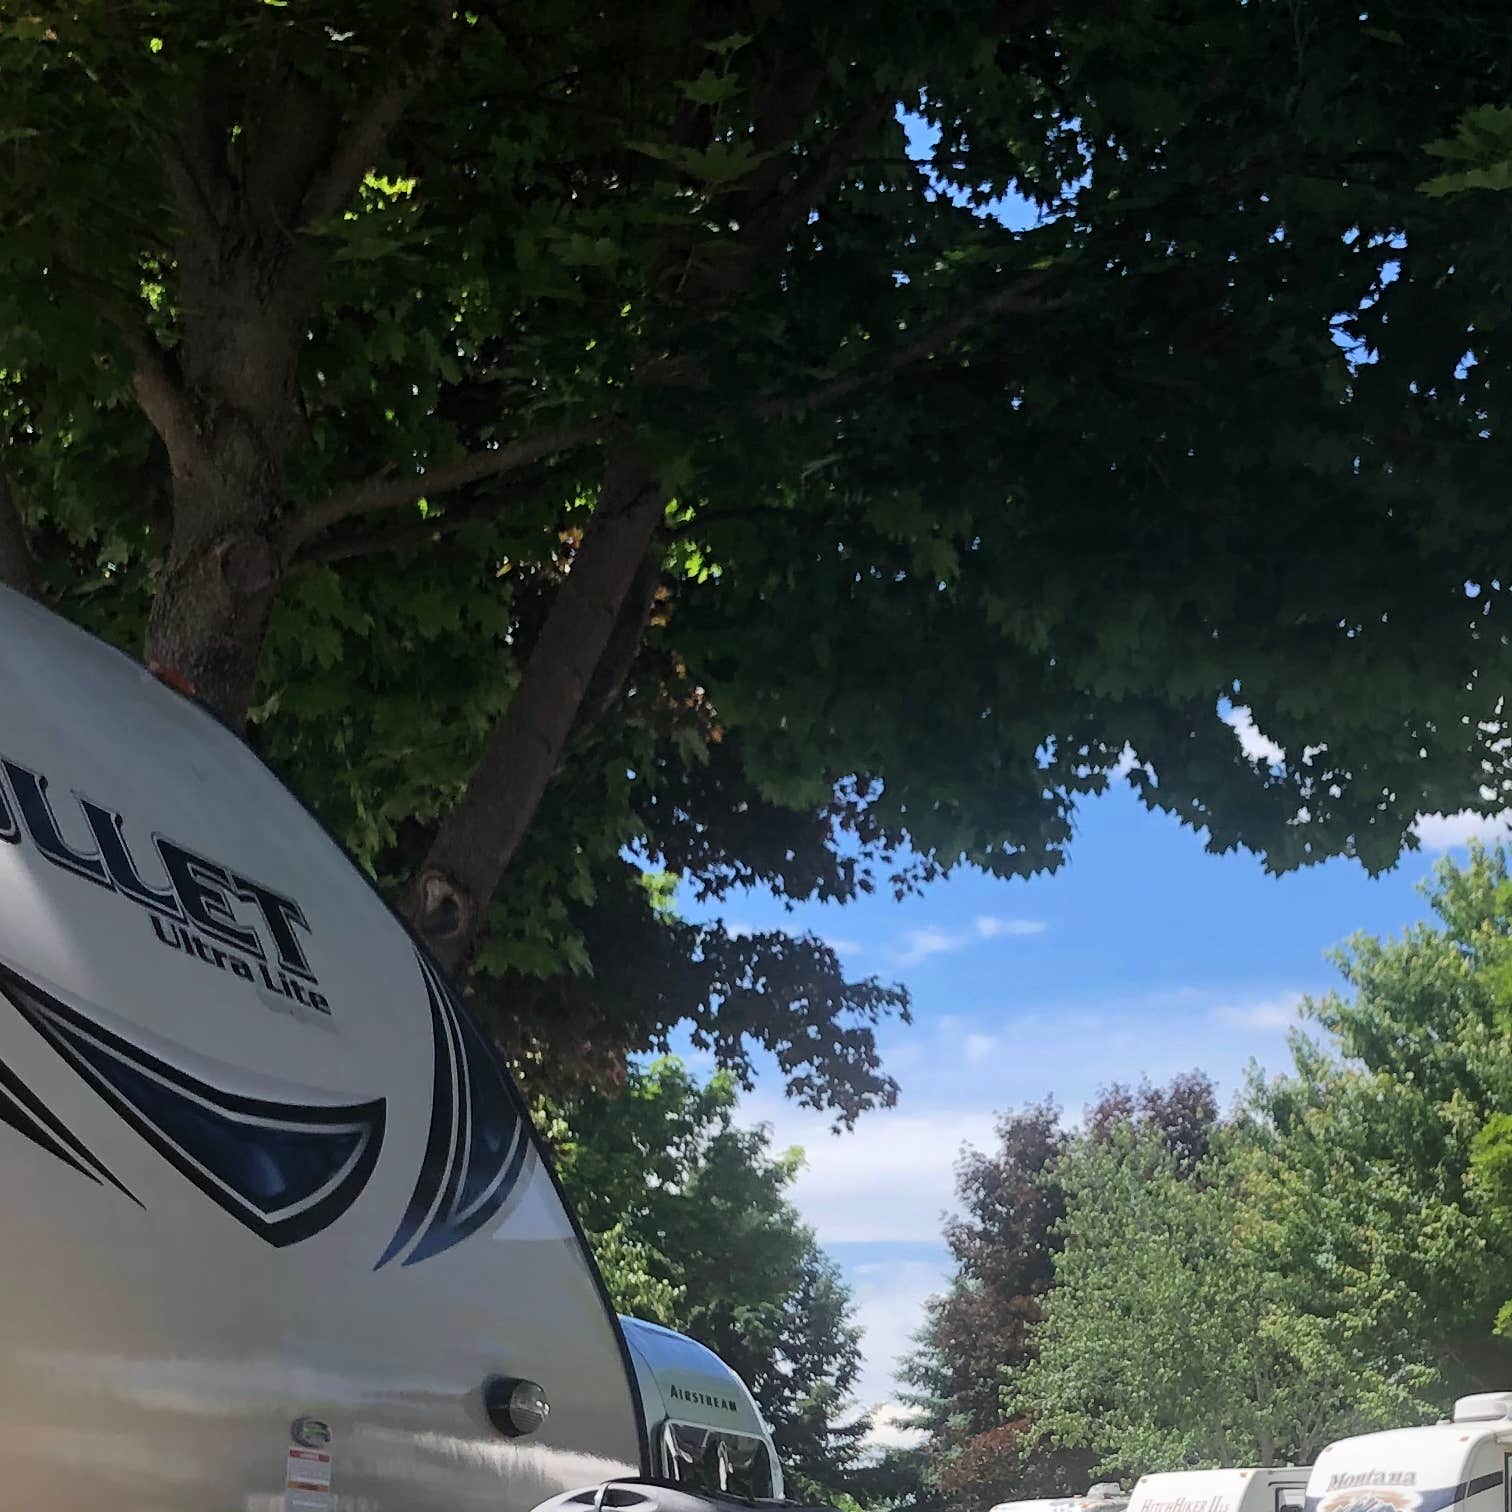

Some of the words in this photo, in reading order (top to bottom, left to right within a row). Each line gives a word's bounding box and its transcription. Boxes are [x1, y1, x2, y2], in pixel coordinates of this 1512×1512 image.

[0, 757, 318, 985] LLET
[149, 912, 254, 983] Ultra
[257, 960, 332, 1016] Lite
[1326, 1468, 1416, 1492] Montana
